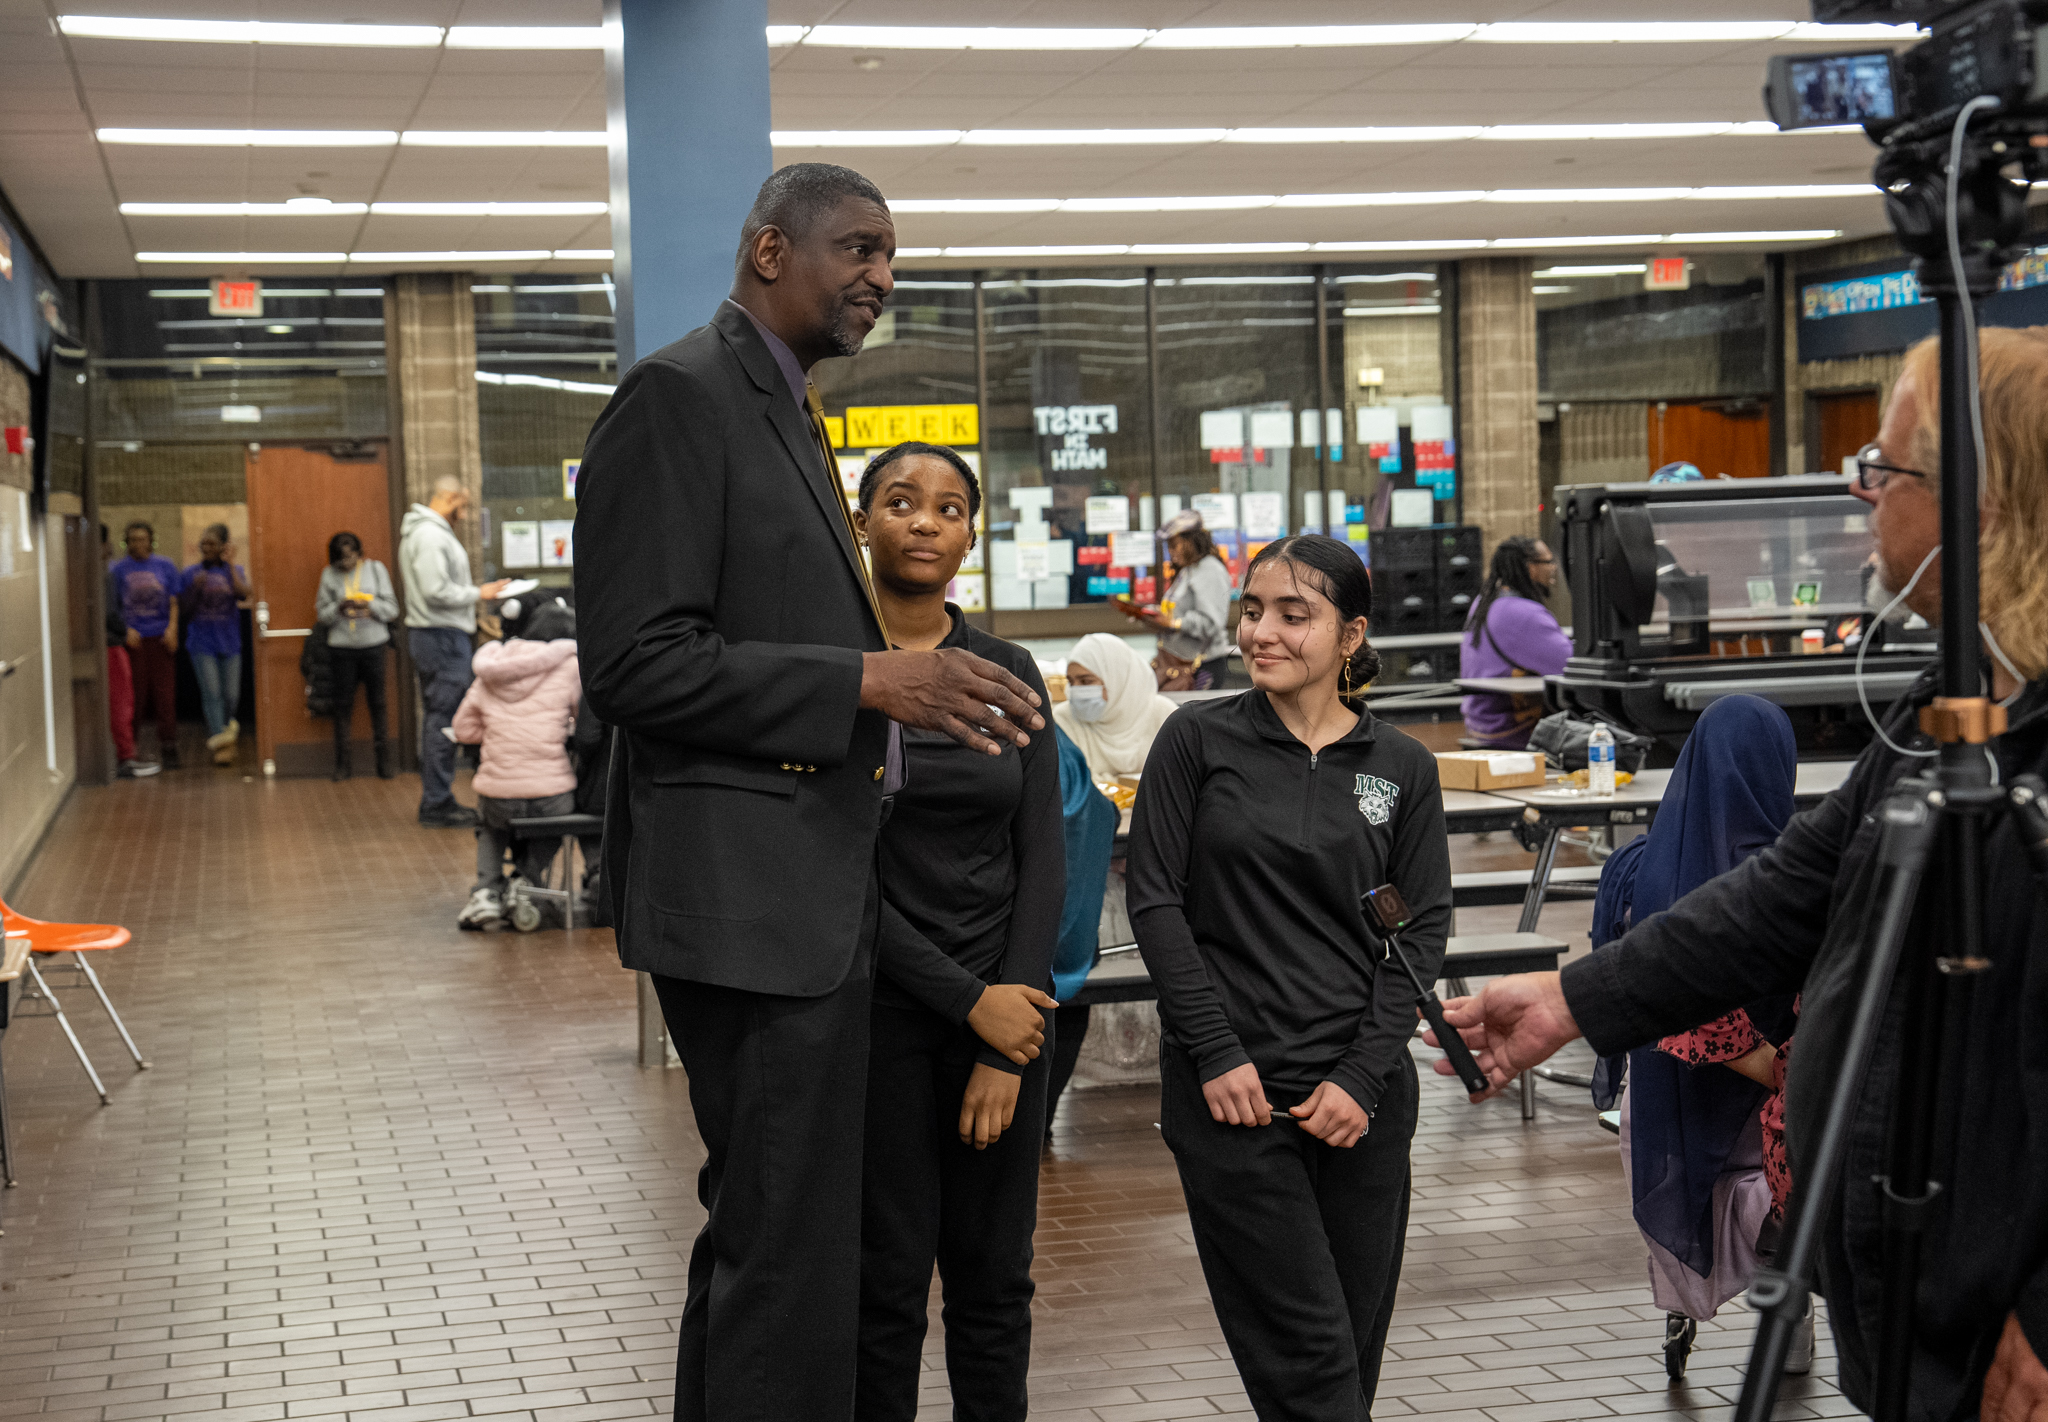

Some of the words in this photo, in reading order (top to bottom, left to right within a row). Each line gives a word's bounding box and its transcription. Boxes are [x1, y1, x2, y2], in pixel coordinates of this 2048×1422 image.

[1653, 257, 1684, 283] EXIT
[218, 281, 256, 309] EXIT
[852, 413, 969, 440] WEEK
[1353, 773, 1400, 807] MST
